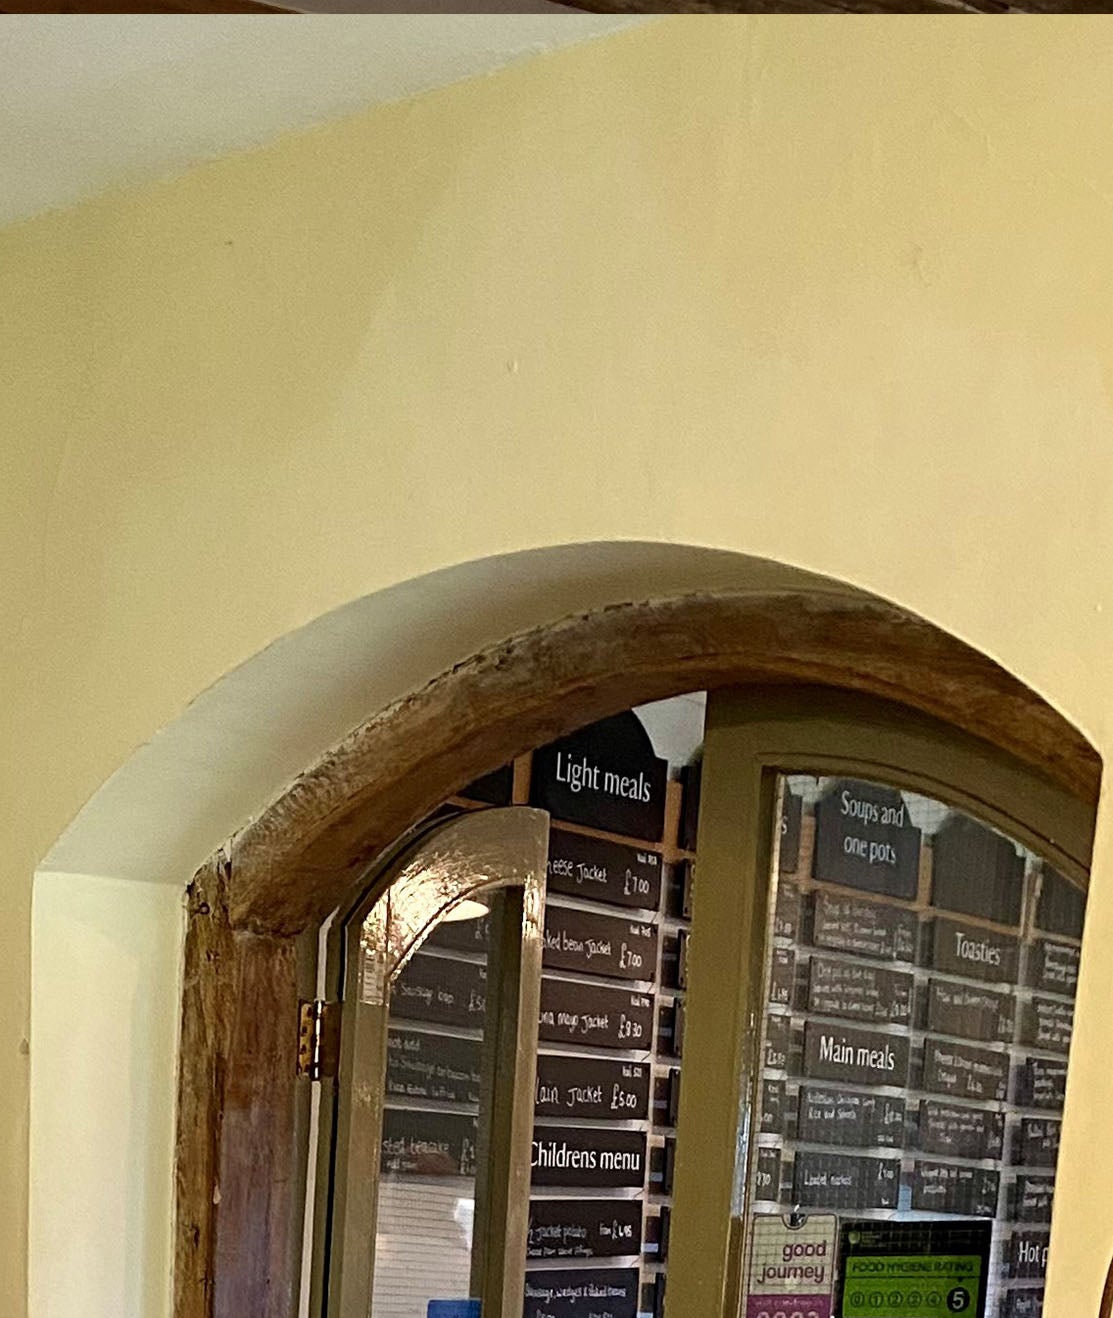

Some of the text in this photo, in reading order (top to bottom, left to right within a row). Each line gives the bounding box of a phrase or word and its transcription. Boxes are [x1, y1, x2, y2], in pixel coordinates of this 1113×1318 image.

[555, 750, 651, 803] Light meals
[840, 790, 905, 828] Soups and
[843, 836, 897, 864] one pots
[954, 932, 1001, 966] Toasties
[538, 1011, 555, 1026] una
[819, 1035, 895, 1070] Main meals
[534, 1077, 560, 1105] lain
[531, 1141, 641, 1171] Childrens menu
[782, 1240, 827, 1262] good
[1017, 1241, 1039, 1263] Hot
[756, 1262, 826, 1284] journey
[852, 1261, 885, 1273] FOOD
[951, 1290, 965, 1310] 5
